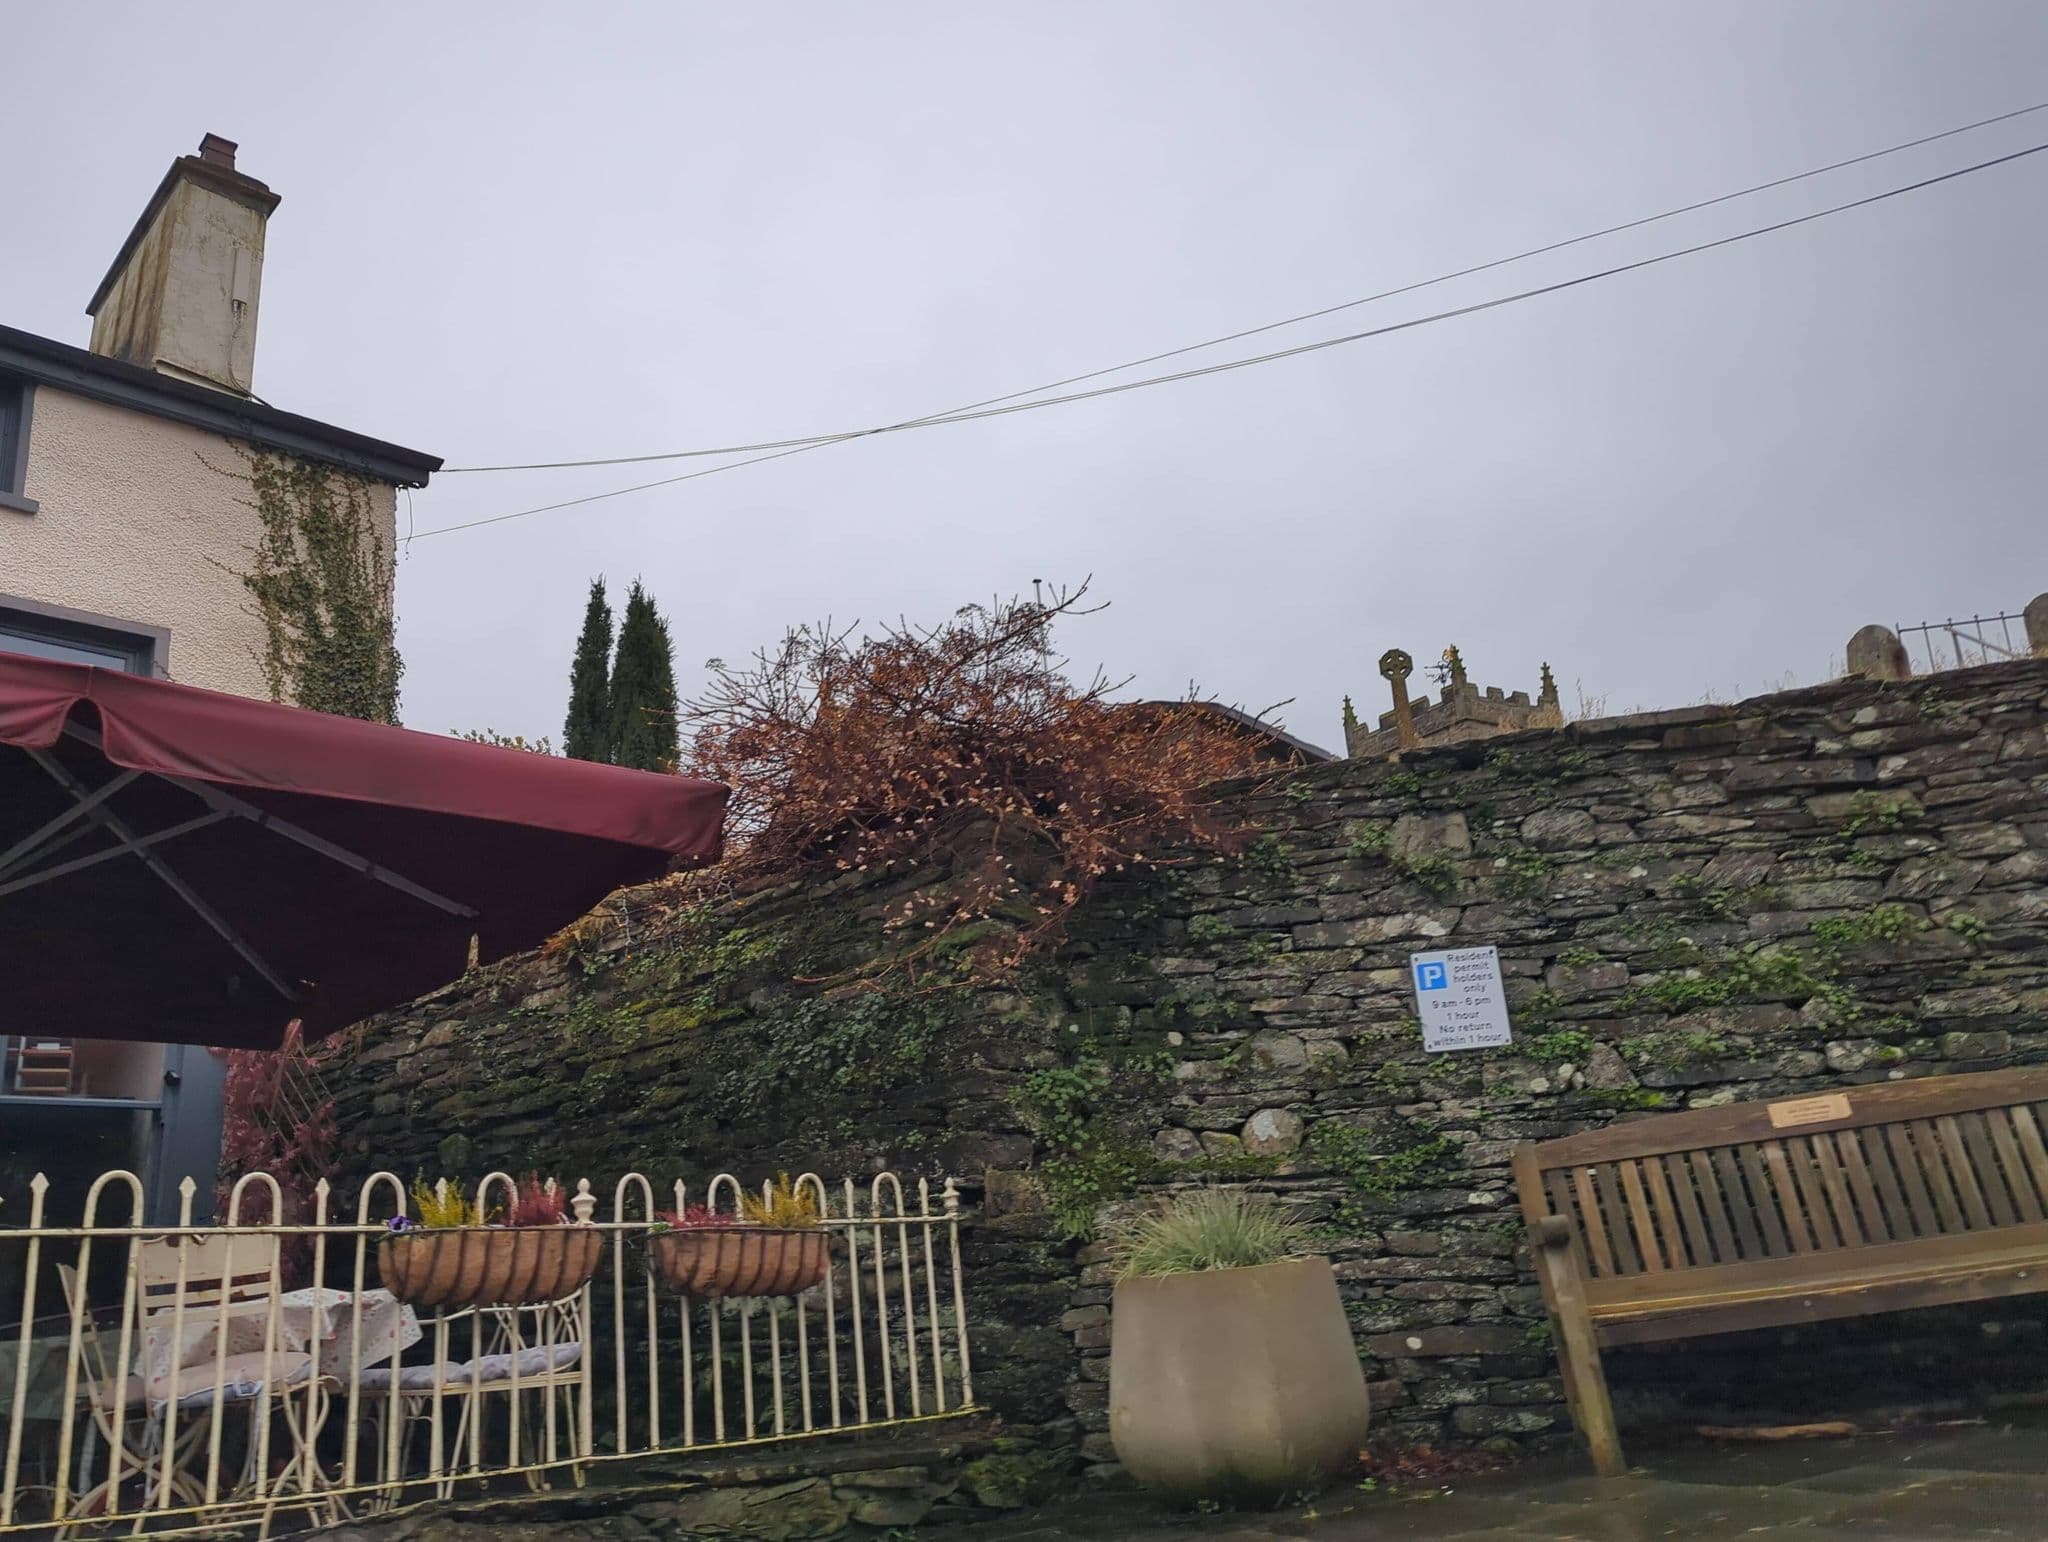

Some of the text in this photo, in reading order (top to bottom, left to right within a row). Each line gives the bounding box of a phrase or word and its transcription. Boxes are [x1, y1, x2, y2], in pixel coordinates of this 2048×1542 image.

[1447, 951, 1494, 962] Resident
[1453, 961, 1490, 973] permit
[1423, 965, 1442, 988] P
[1453, 972, 1494, 983] holders
[1463, 983, 1487, 993] only
[1455, 1011, 1480, 1020] hour
[1440, 1022, 1493, 1034] No return
[1433, 1035, 1466, 1046] within
[1477, 1033, 1502, 1042] hour
